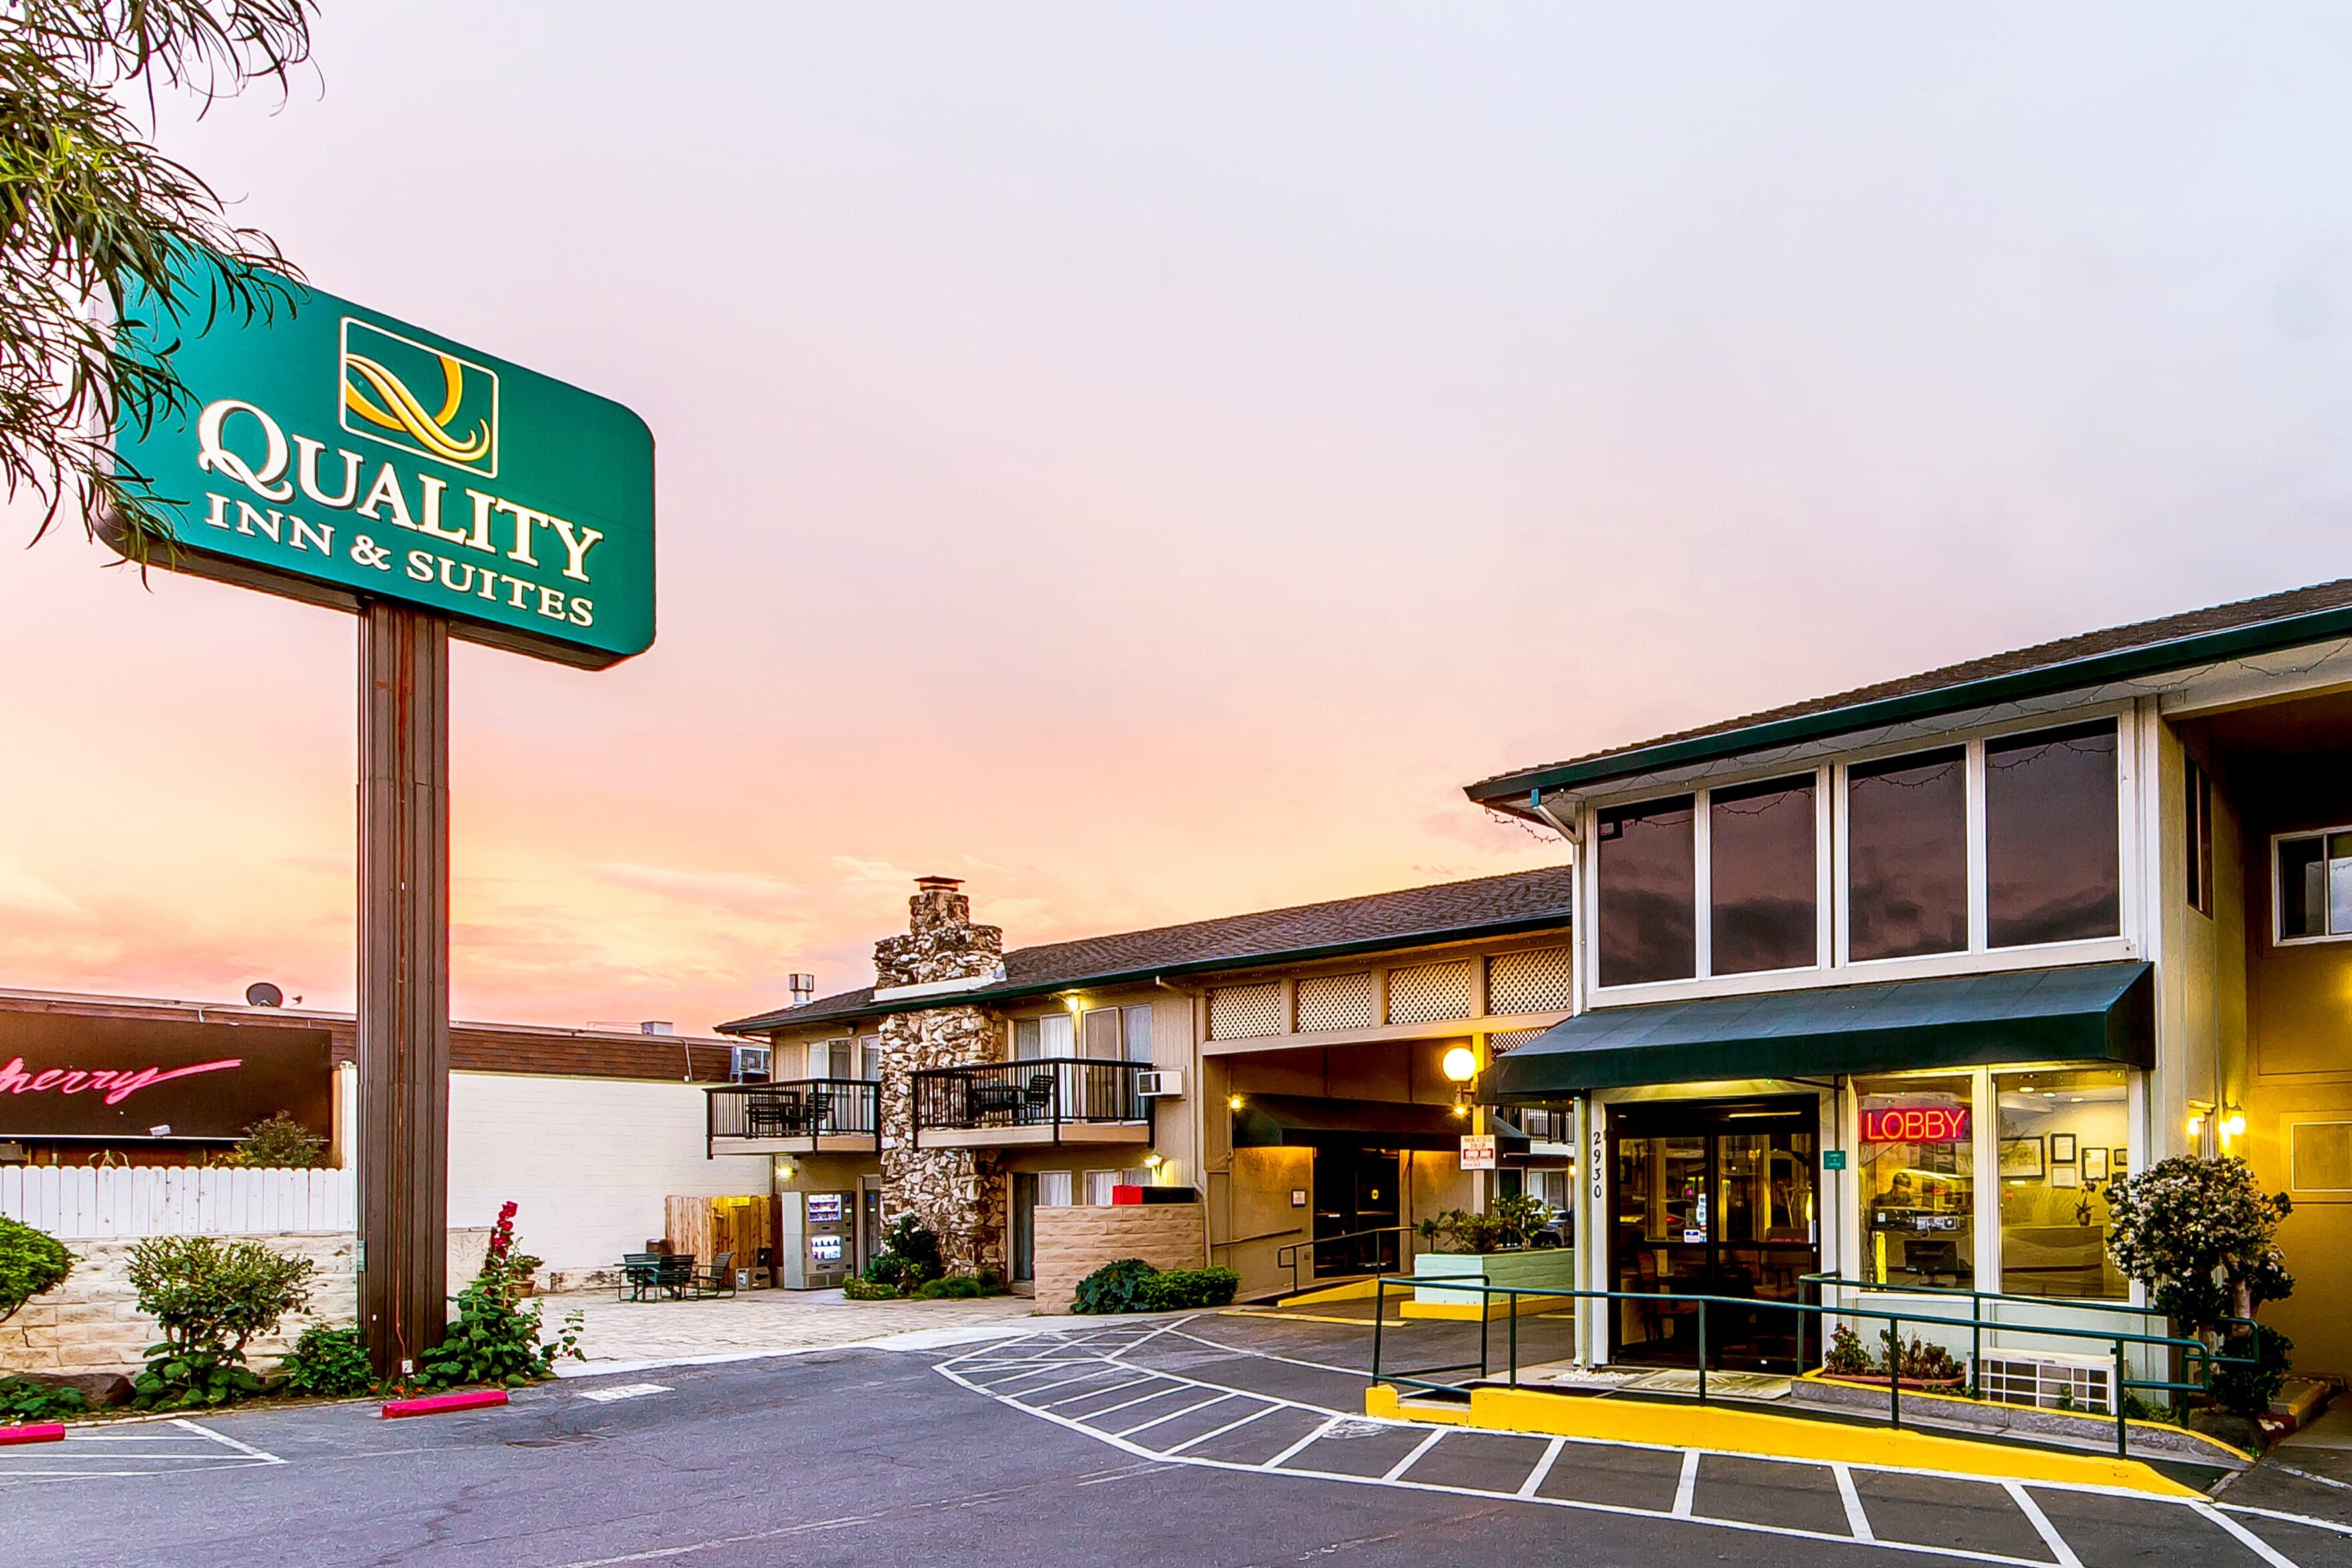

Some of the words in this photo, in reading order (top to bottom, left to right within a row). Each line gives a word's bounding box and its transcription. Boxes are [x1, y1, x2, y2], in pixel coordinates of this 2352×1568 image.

[199, 400, 604, 582] QUALITY
[205, 492, 335, 557] INN
[351, 533, 392, 571] &
[406, 550, 594, 627] SUITES
[1592, 1131, 1602, 1199] 2930
[1867, 1109, 1967, 1140] LOBBY
